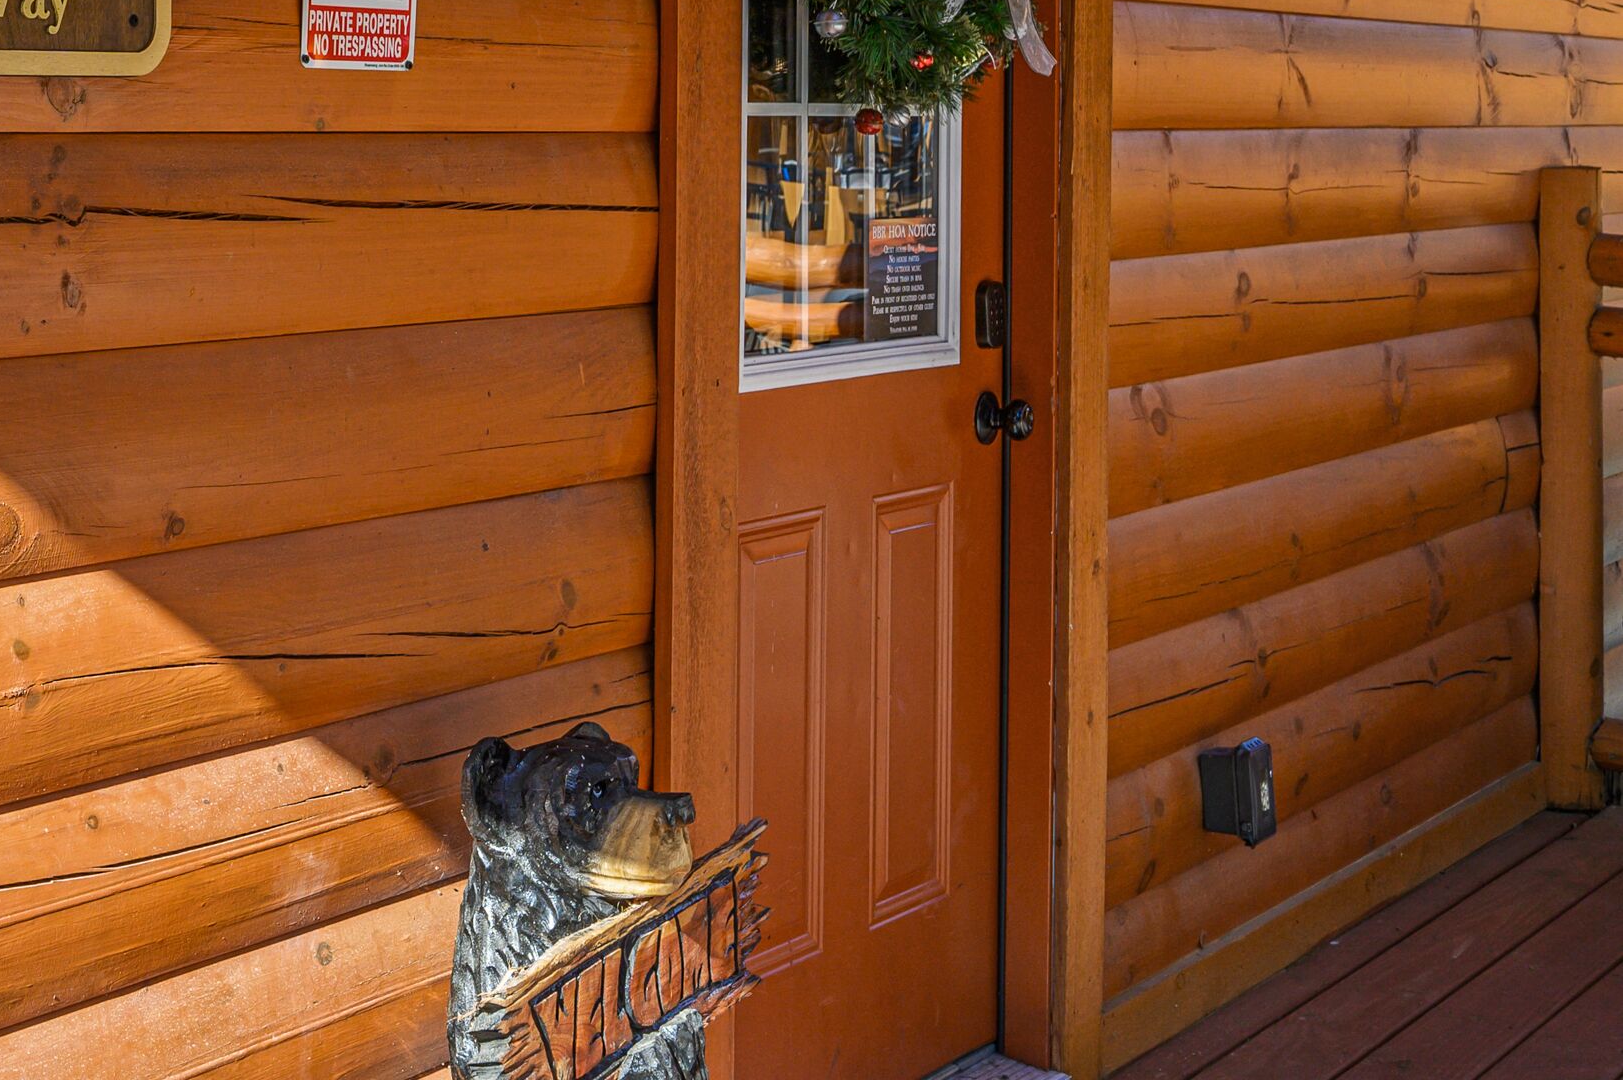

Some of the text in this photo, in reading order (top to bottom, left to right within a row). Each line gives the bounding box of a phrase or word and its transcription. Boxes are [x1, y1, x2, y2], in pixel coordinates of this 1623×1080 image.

[309, 9, 410, 36] PRIVATE PROPERTY
[313, 35, 402, 59] NO TRESPASSING
[872, 223, 937, 239] BBR HOA NOTICE
